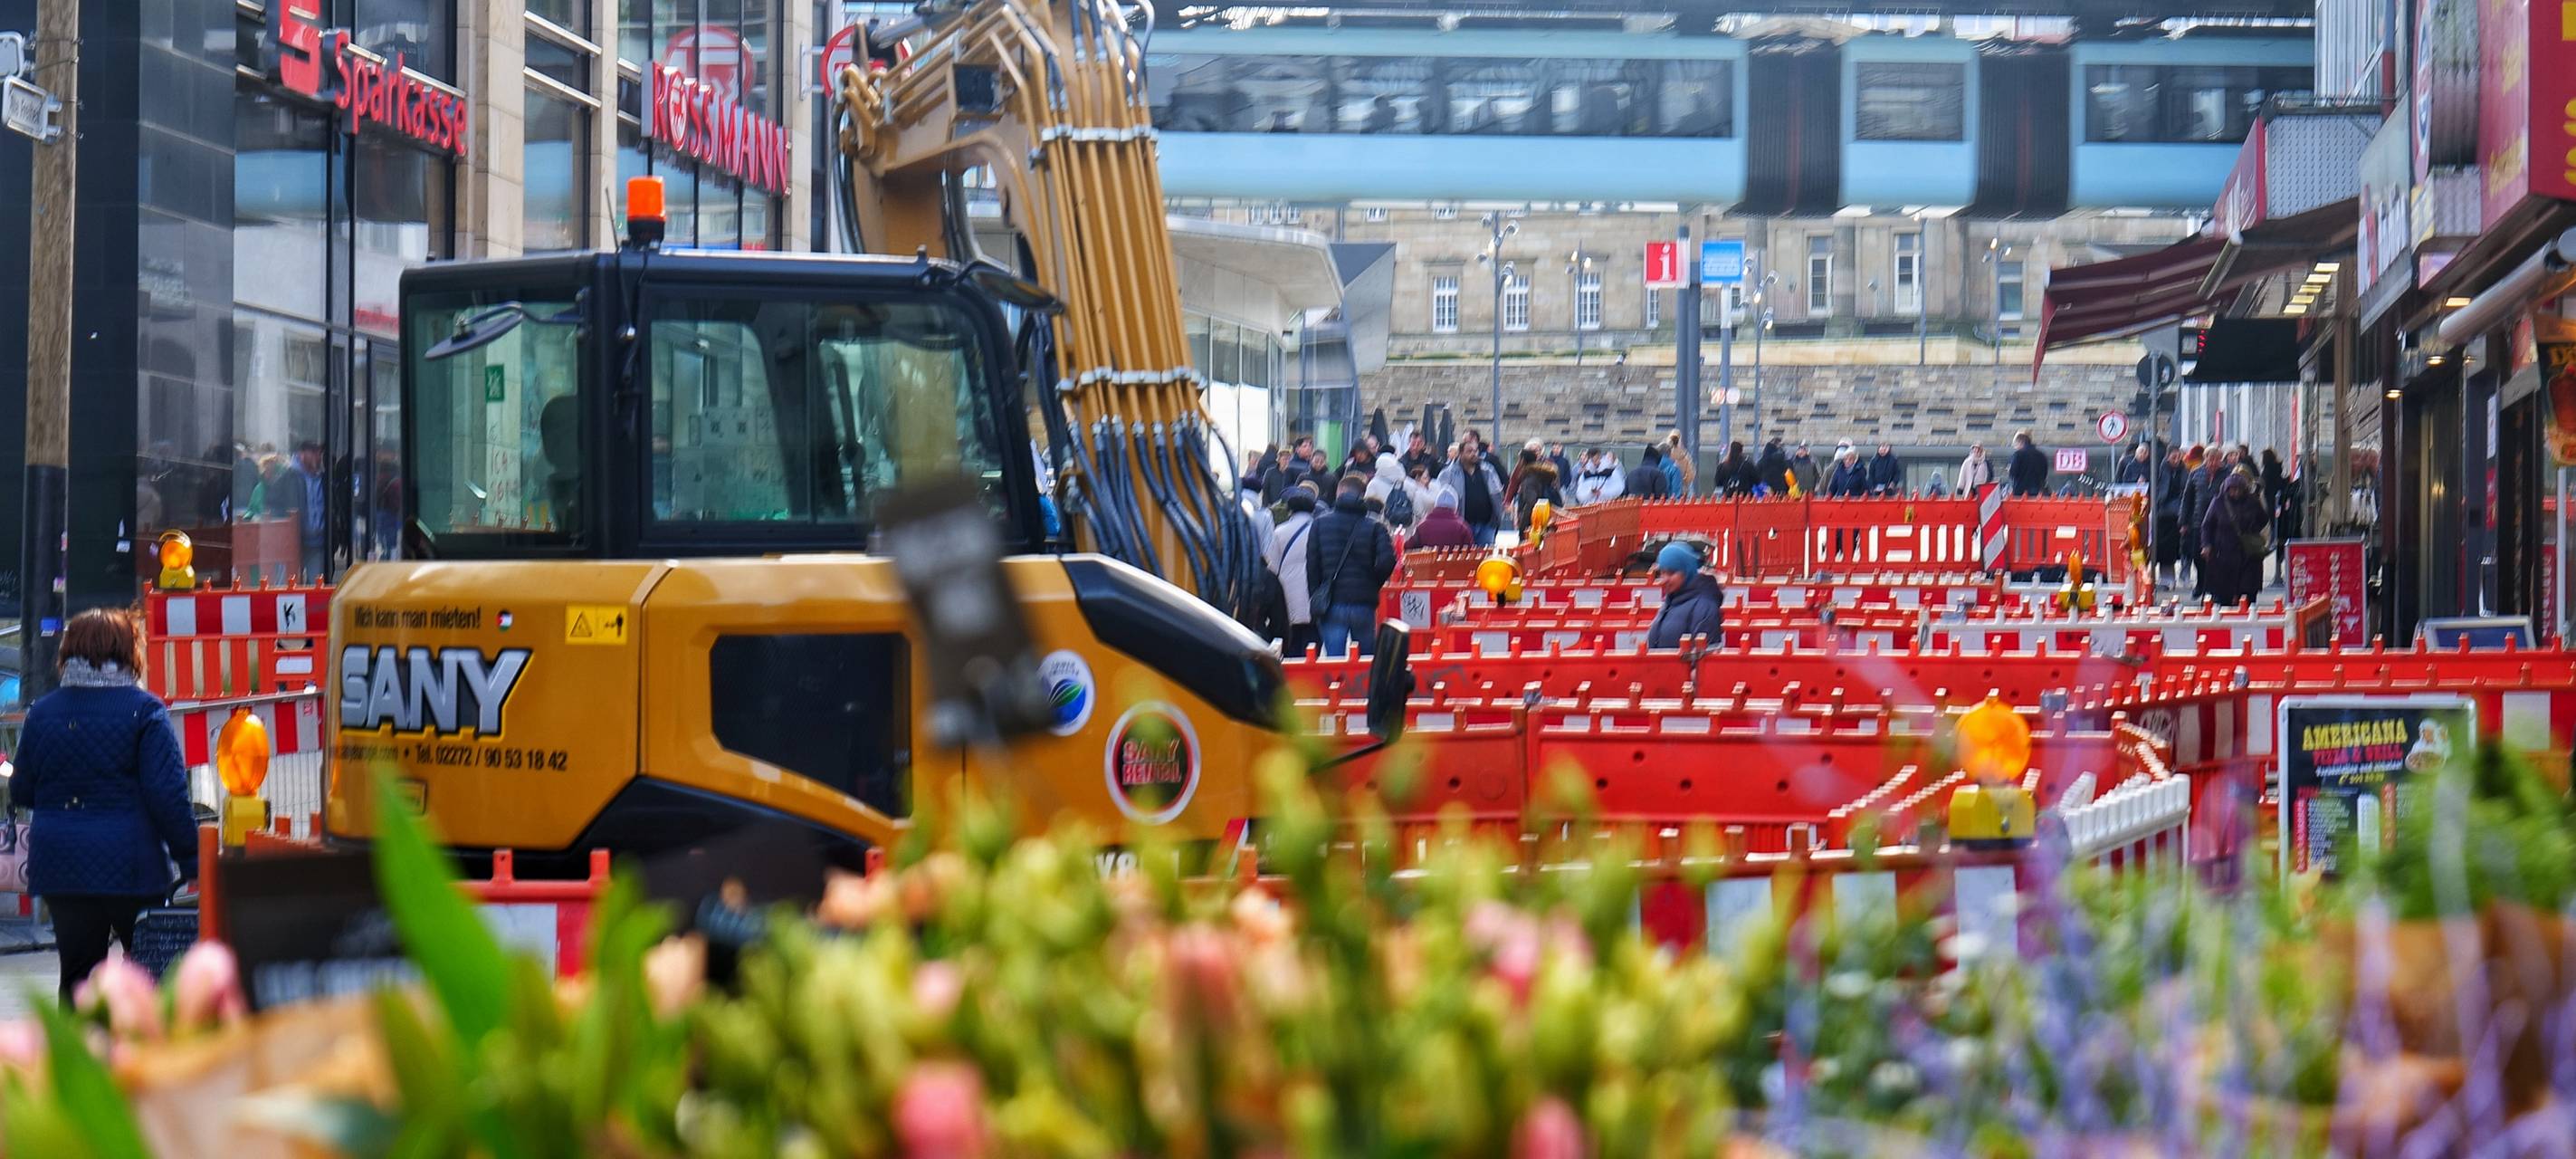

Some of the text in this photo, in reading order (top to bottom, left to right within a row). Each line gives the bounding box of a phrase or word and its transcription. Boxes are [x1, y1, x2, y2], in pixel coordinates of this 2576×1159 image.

[334, 29, 468, 157] Sparkasse
[652, 61, 789, 196] ROSSMANN
[1659, 243, 1674, 282] i
[2058, 452, 2084, 470] DB
[376, 606, 398, 629] kann
[402, 608, 427, 629] man
[430, 606, 482, 629] mieten!
[340, 646, 532, 735] SANY
[2302, 717, 2409, 752] AMERICANA
[415, 743, 434, 764] Tel.
[435, 744, 473, 766] 02272
[484, 747, 501, 768] 90
[505, 748, 522, 769] 53
[527, 749, 544, 770] 18
[549, 751, 568, 771] 42
